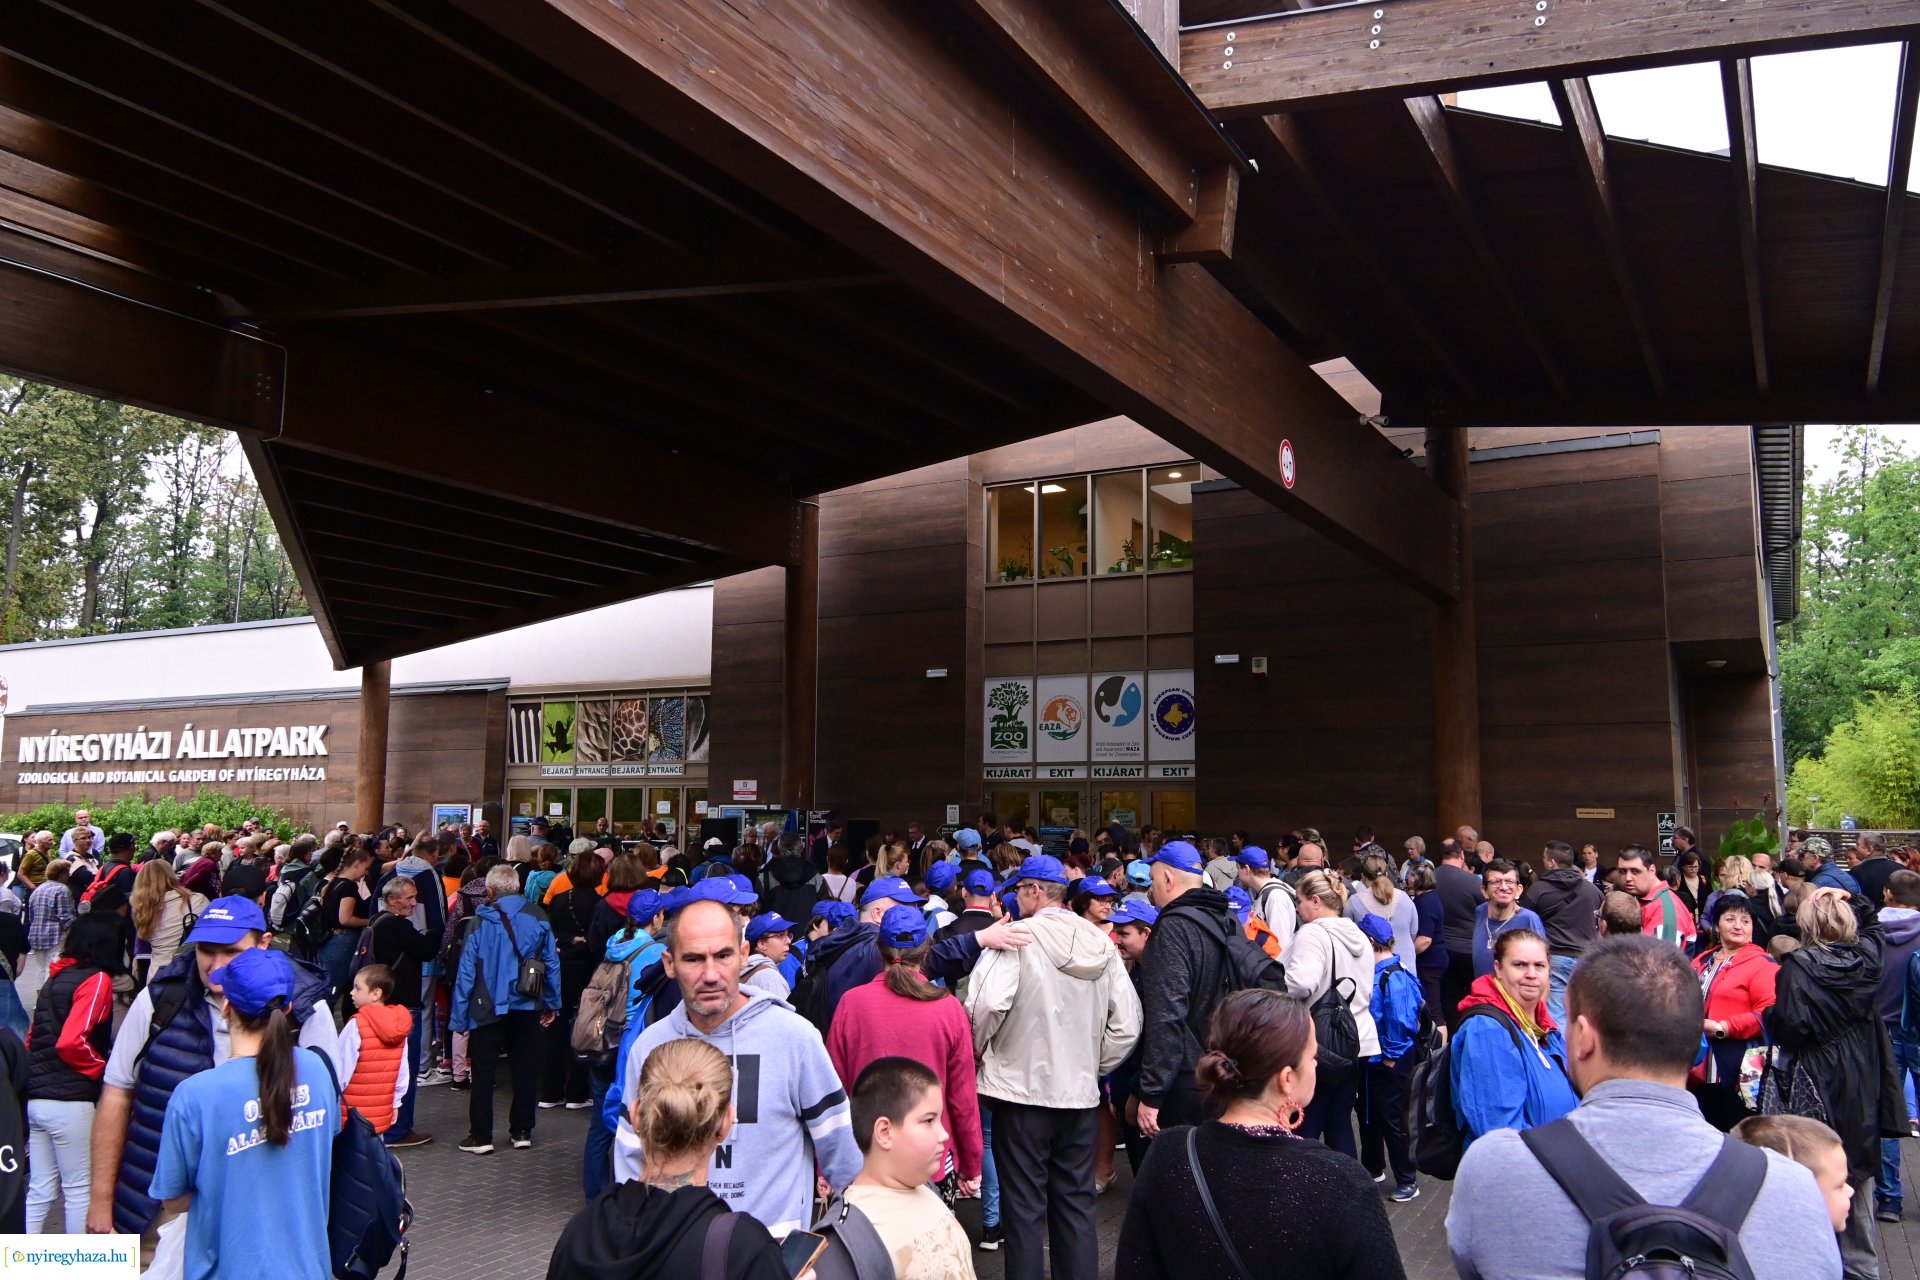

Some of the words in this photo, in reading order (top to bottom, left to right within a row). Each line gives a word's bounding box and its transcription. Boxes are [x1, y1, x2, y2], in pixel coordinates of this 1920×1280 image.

[1152, 687, 1181, 705] EUROPEAN
[1039, 722, 1061, 731] EAZA
[994, 731, 1024, 741] ZOO
[18, 727, 171, 763] NYÍREGYHÁZI
[176, 724, 328, 759] ÁLLATPARK
[18, 770, 80, 784] ZOOLOGICAL
[82, 771, 104, 783] AND
[107, 770, 166, 783] BOTANICAL
[169, 769, 216, 783] GARDEN
[219, 768, 234, 782] OF
[236, 765, 326, 781] NYÍREGYHÁZA
[542, 766, 573, 774] BEJÁRAT
[576, 767, 609, 775] ENTRANCE
[612, 766, 645, 775] BEJÁRAT
[648, 766, 683, 774] ENTRANCE
[986, 768, 1031, 778] KIJÁRAT
[1050, 768, 1074, 777] EXIT
[1093, 767, 1142, 777] KIJÁRAT
[1162, 767, 1190, 776] EXIT
[723, 1181, 745, 1189] BECAUSE
[731, 1191, 745, 1199] DOING
